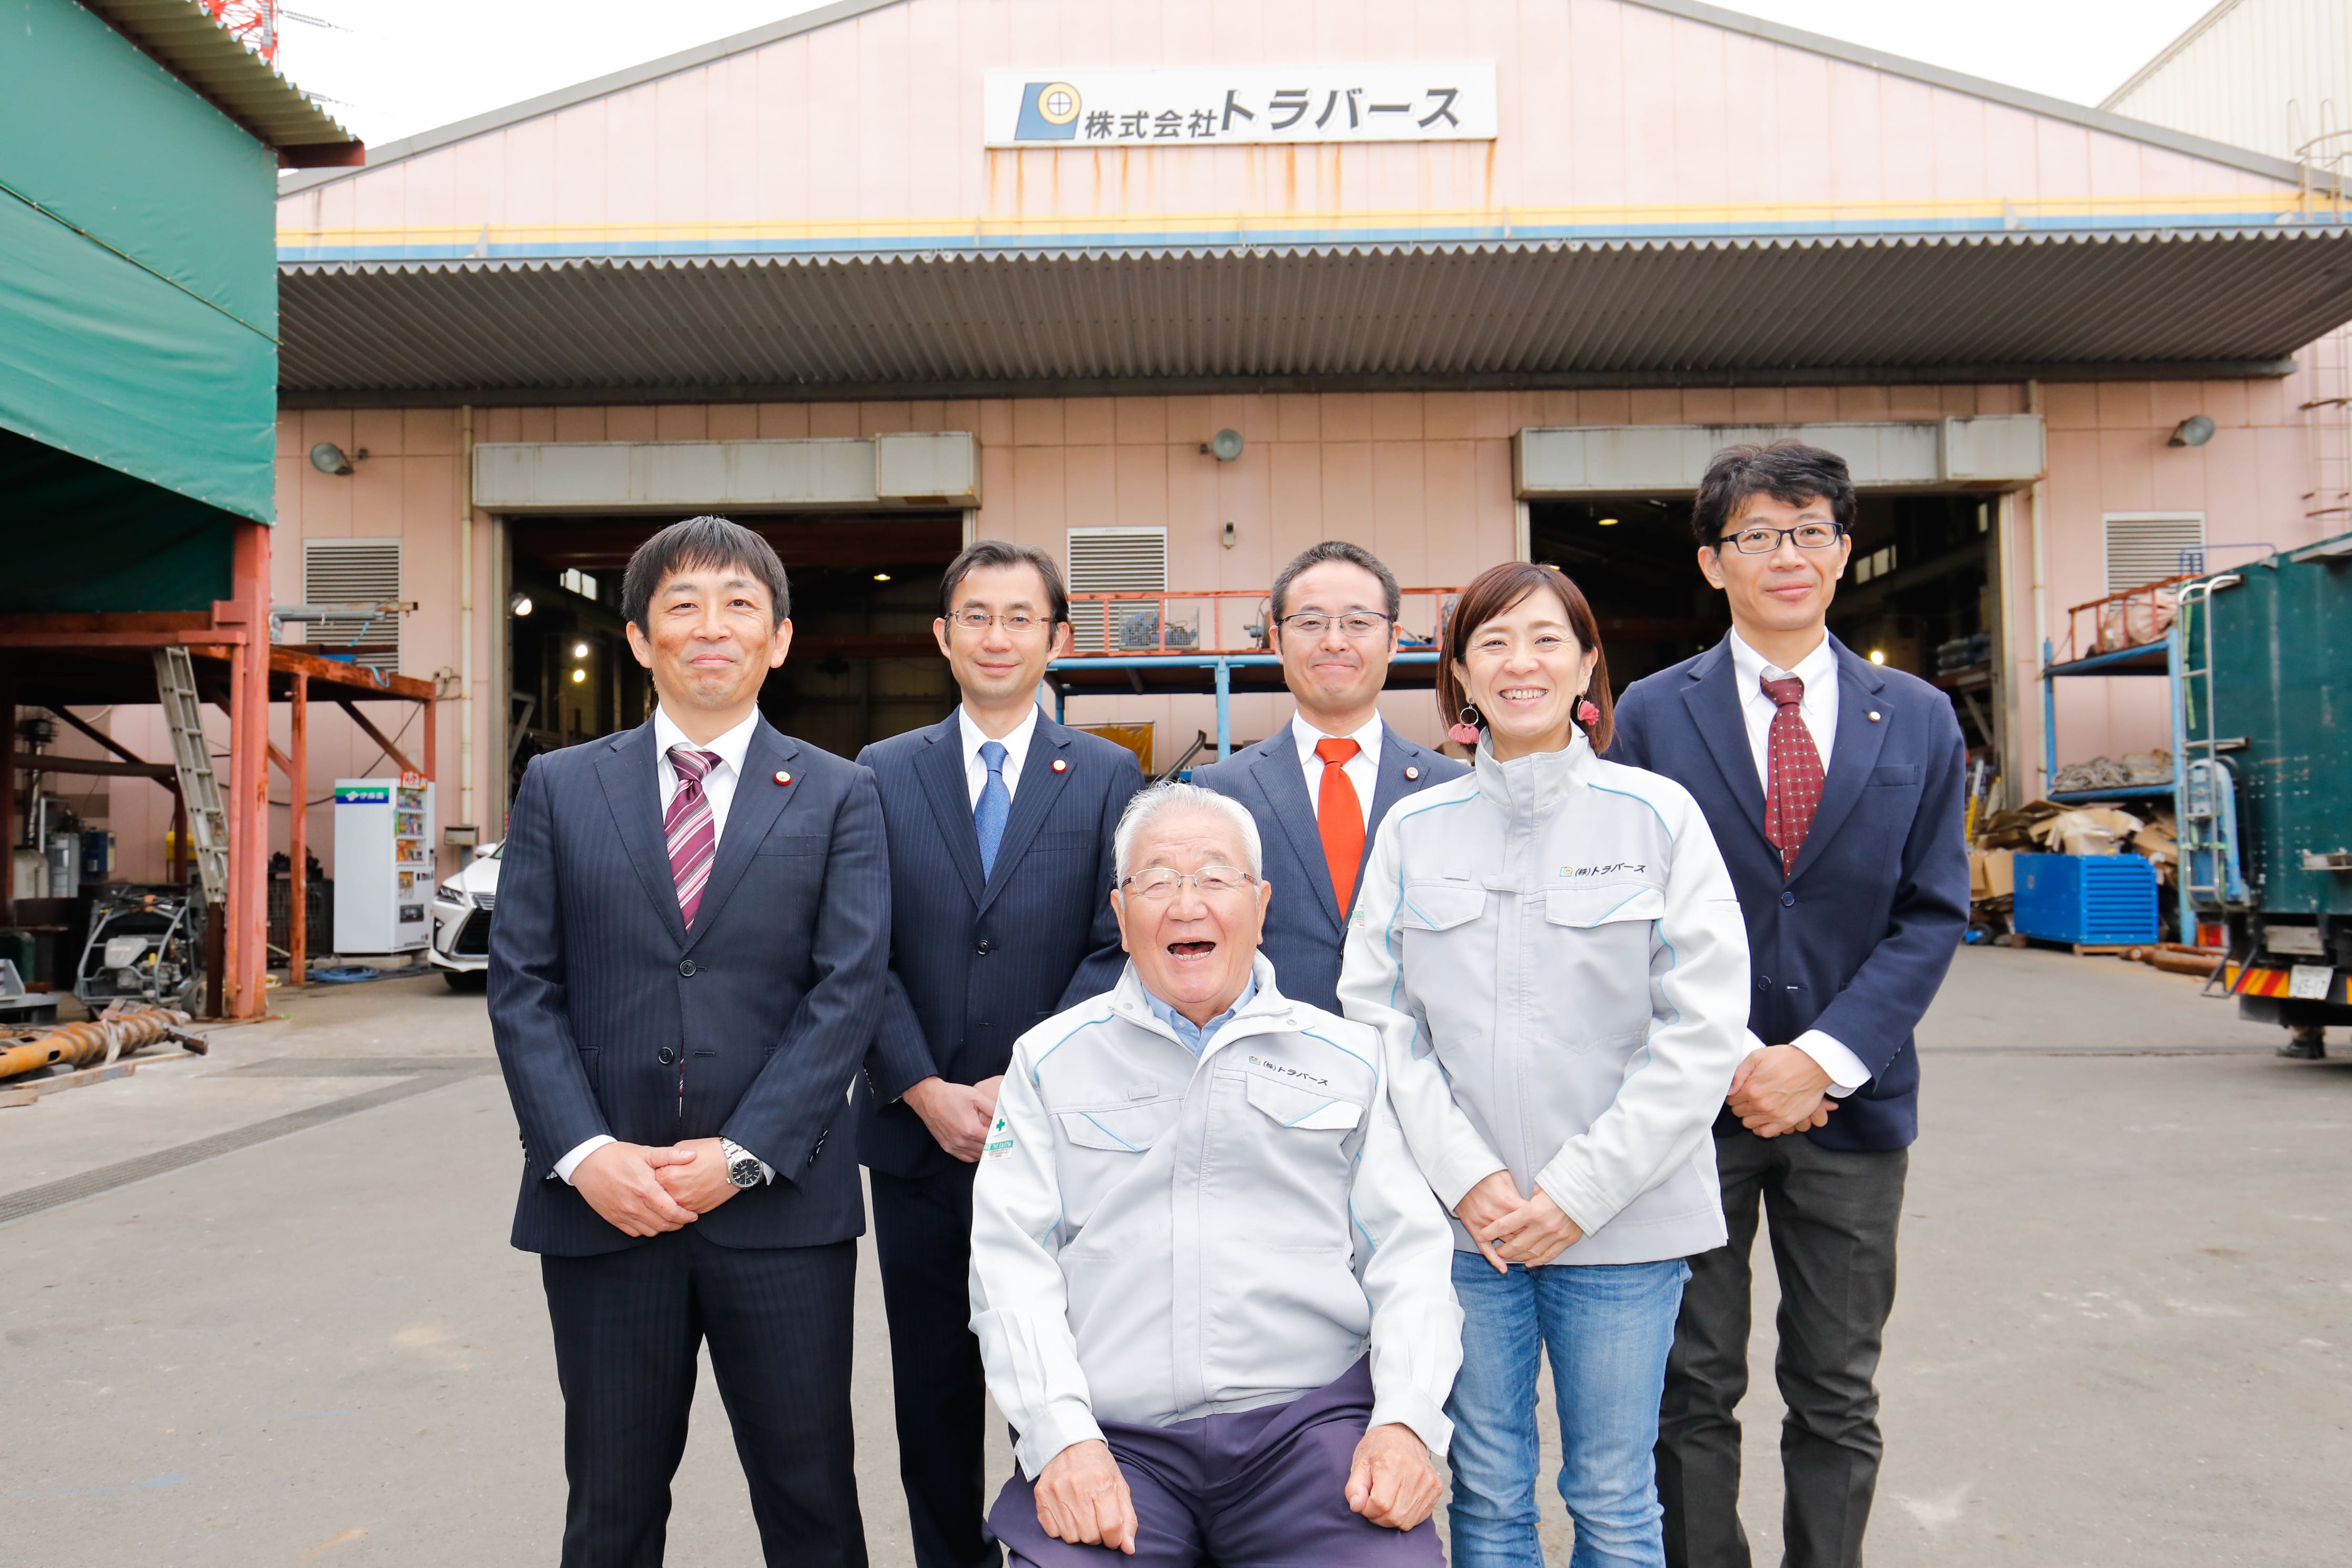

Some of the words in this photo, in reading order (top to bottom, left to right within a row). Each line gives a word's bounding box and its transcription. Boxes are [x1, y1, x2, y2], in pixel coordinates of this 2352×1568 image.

[1084, 87, 1462, 139] 株式会社トラバース
[1574, 863, 1647, 877] (株)トラバース
[1263, 1061, 1328, 1086] (株)トラバース
